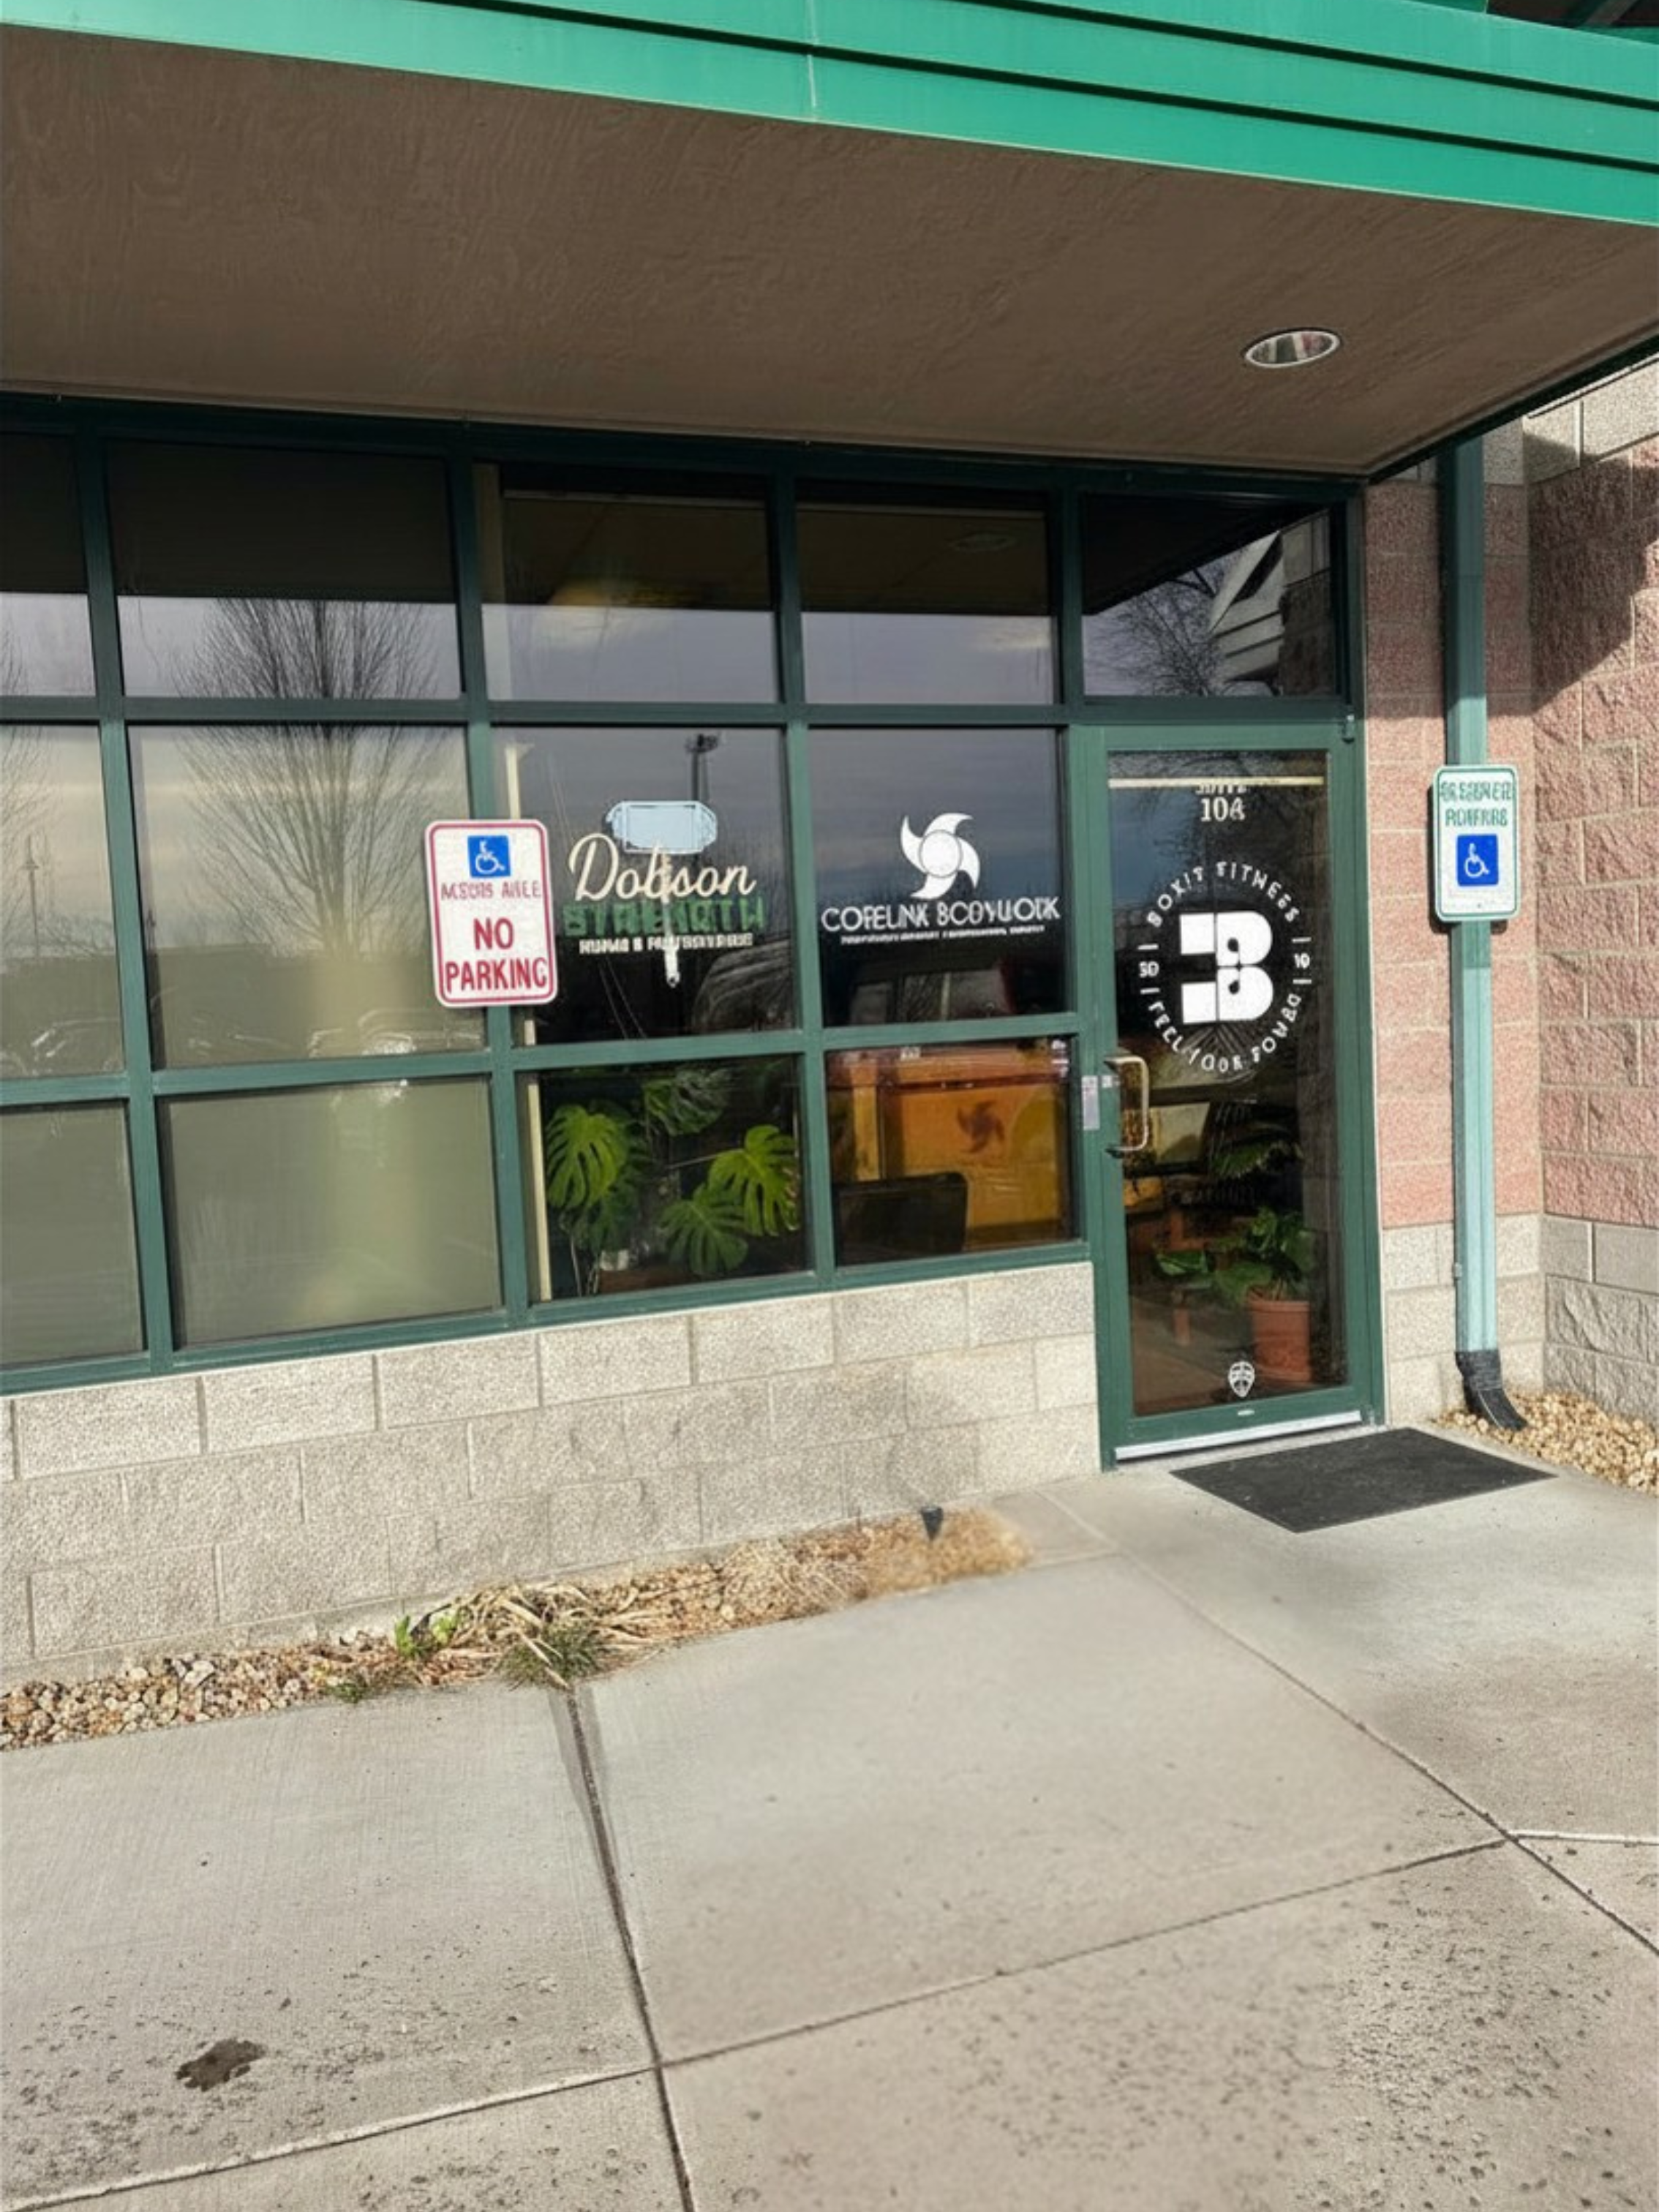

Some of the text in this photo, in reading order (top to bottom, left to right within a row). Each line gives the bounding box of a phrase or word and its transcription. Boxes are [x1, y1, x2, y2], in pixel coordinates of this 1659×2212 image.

[568, 832, 757, 901] Dobson
[473, 917, 514, 950] NO
[445, 957, 548, 993] PARKING
